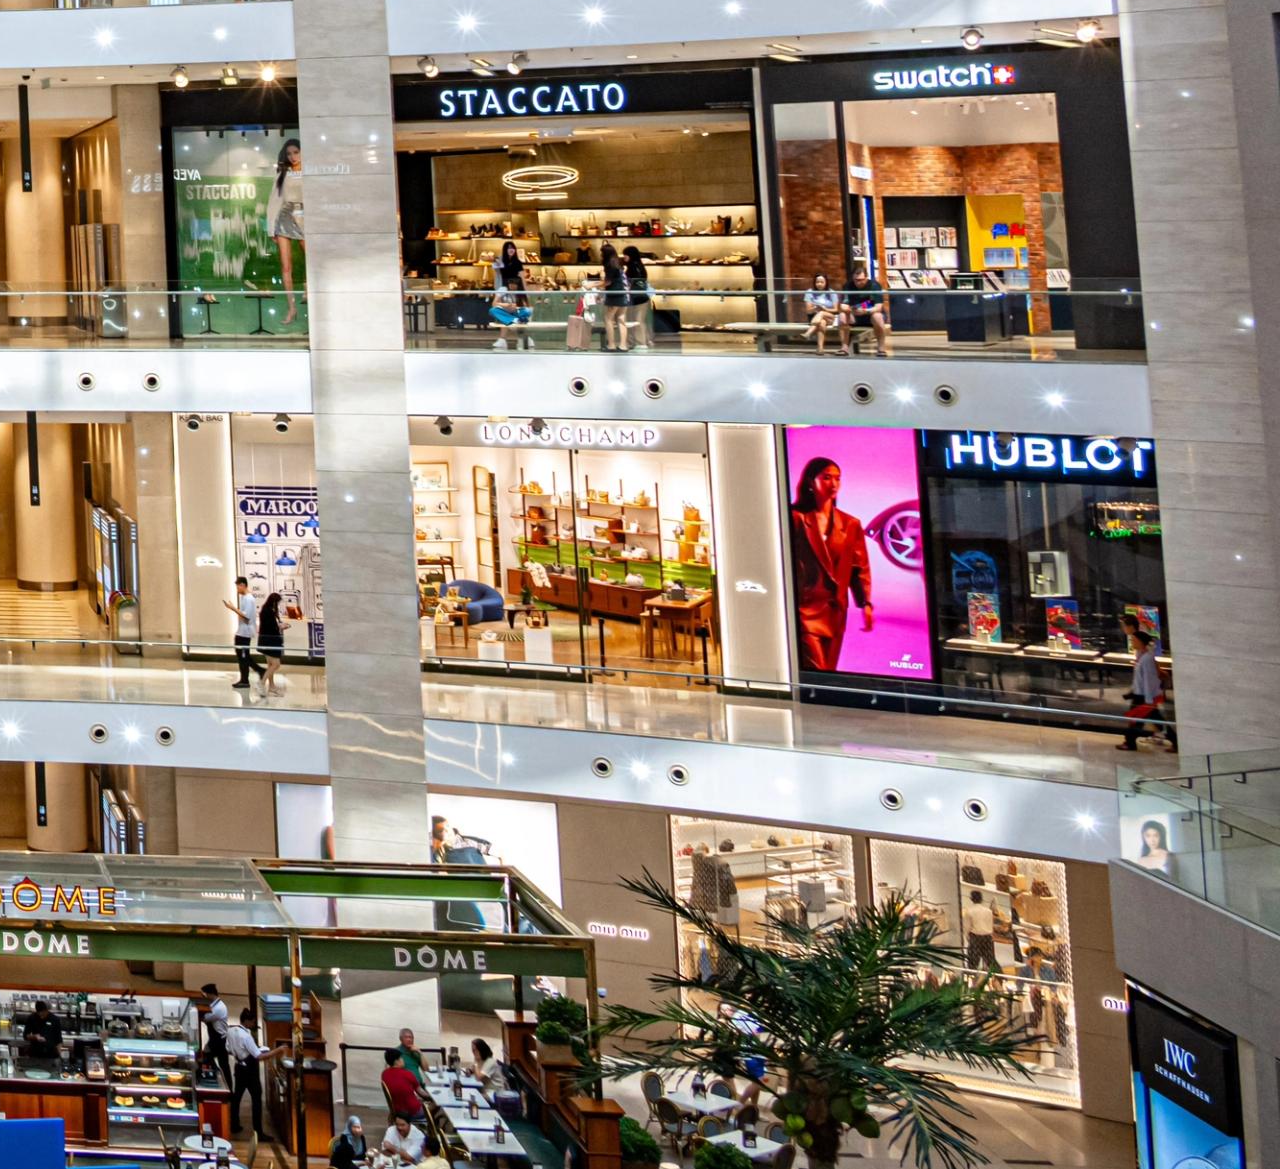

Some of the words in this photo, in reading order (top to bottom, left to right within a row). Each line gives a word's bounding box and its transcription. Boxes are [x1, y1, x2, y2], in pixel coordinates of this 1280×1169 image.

[873, 62, 992, 90] swatch
[440, 83, 625, 117] STACCATO
[186, 183, 256, 200] STACCATO
[206, 414, 224, 422] BAG
[483, 424, 656, 445] LONGCHAMP
[950, 433, 1152, 472] HUBLOT
[889, 660, 925, 671] HUBLOT
[1, 929, 91, 956] DÔME
[393, 944, 489, 972] DÔME
[1163, 1037, 1197, 1078] IWC
[1154, 1062, 1211, 1104] SCHAFFHAUSEN
